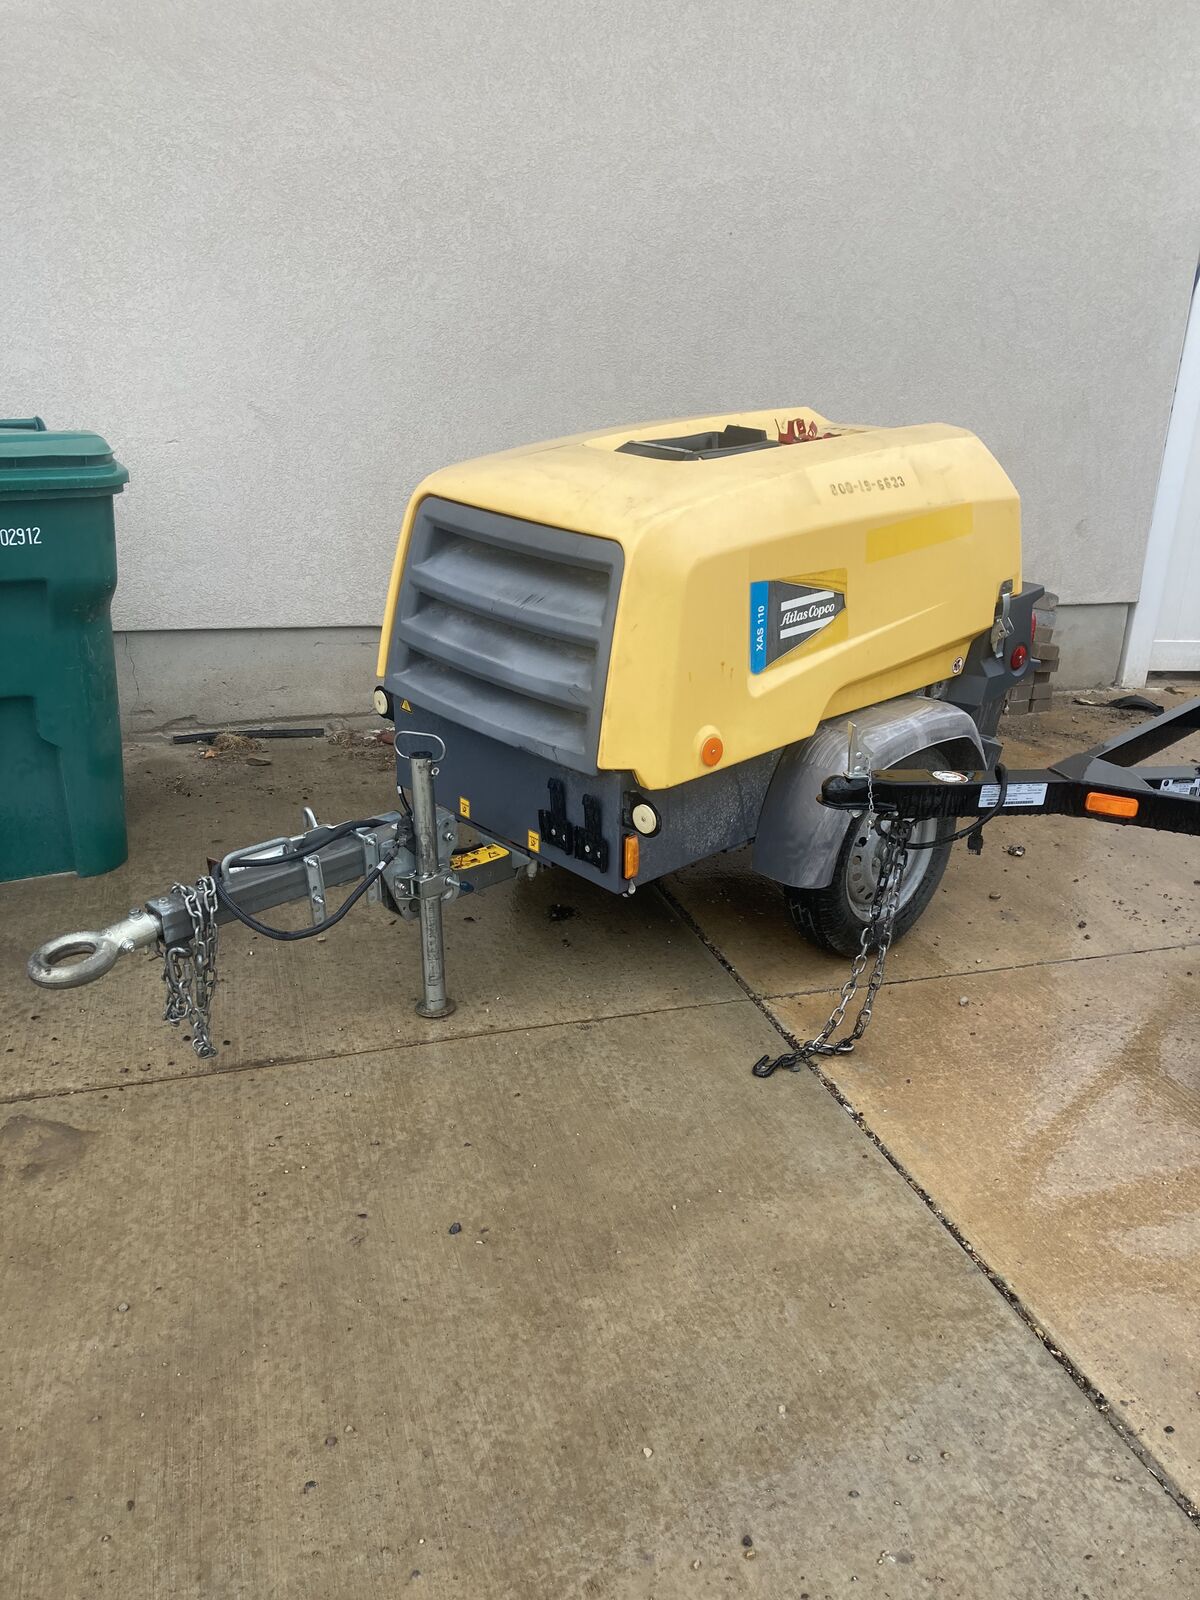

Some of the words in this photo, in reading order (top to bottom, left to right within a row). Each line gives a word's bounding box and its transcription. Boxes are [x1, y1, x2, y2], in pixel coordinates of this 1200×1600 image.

[0, 527, 42, 546] 02912
[757, 605, 765, 624] 110
[780, 611, 808, 626] Atlas
[808, 603, 835, 618] Copco
[756, 628, 764, 651] XAS
